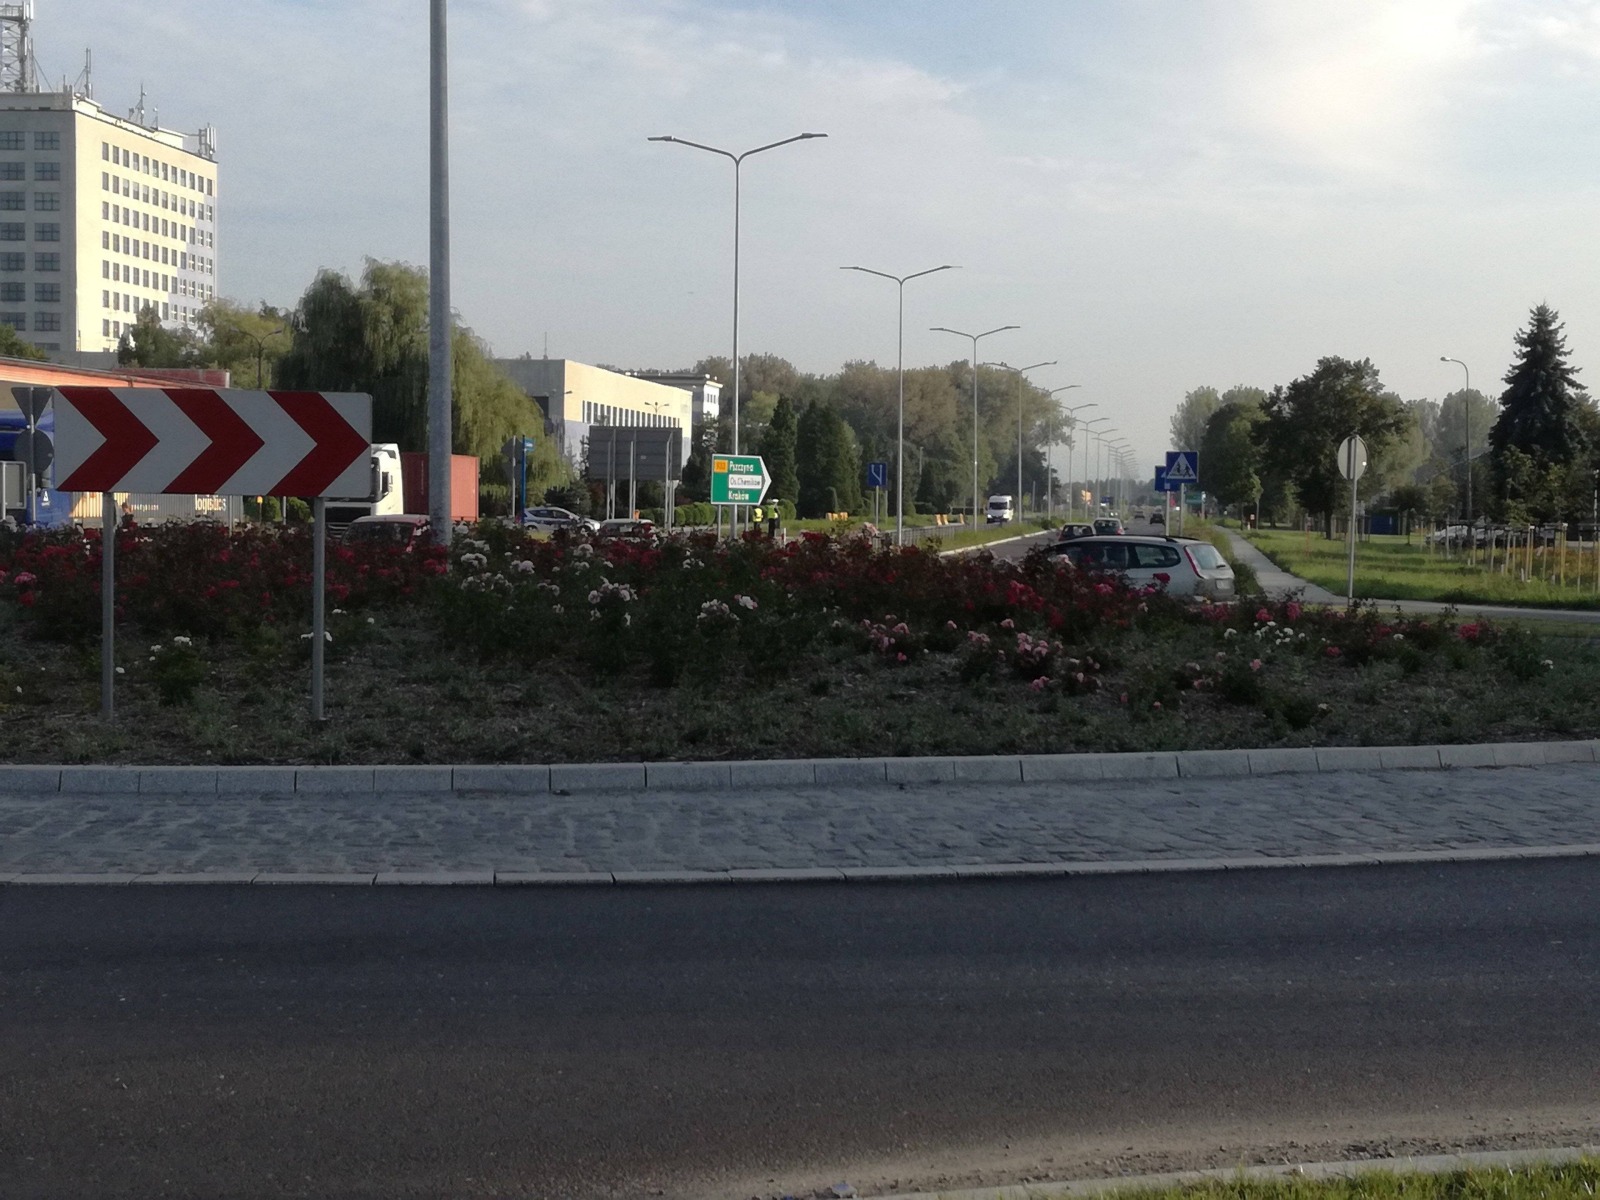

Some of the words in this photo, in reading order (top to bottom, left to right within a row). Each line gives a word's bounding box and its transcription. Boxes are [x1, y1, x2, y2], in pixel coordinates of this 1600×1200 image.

[729, 461, 754, 474] Pszczyna
[728, 490, 749, 500] Kraków
[195, 494, 226, 514] logistics
